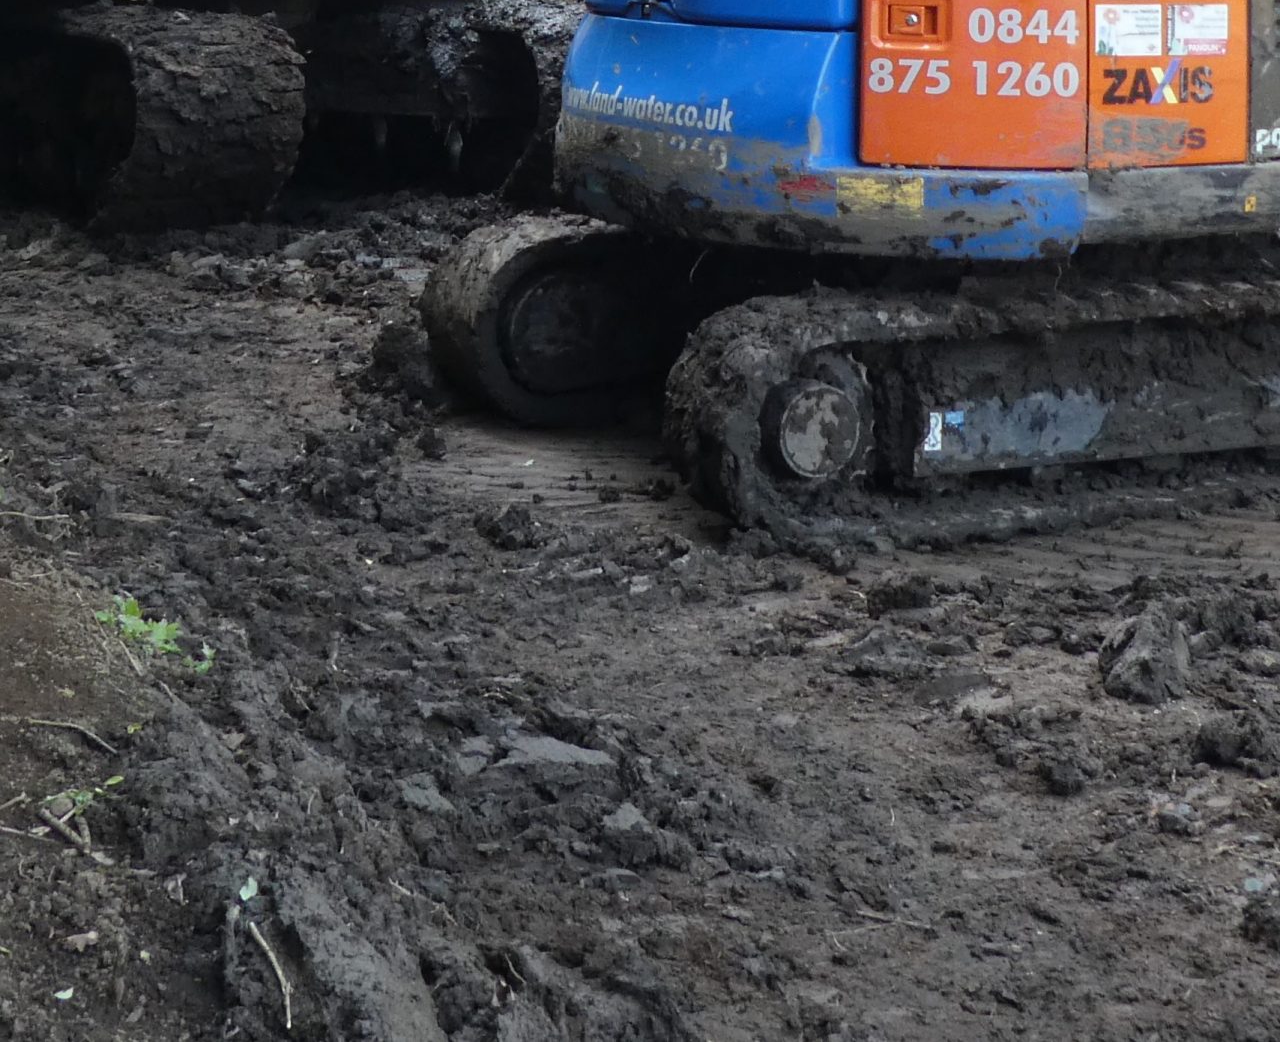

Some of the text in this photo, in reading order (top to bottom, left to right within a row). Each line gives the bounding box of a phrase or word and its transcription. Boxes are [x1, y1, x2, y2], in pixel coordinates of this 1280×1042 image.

[968, 7, 1079, 45] 0844
[868, 57, 1080, 97] 875 1260
[1102, 58, 1213, 104] ZAXIS
